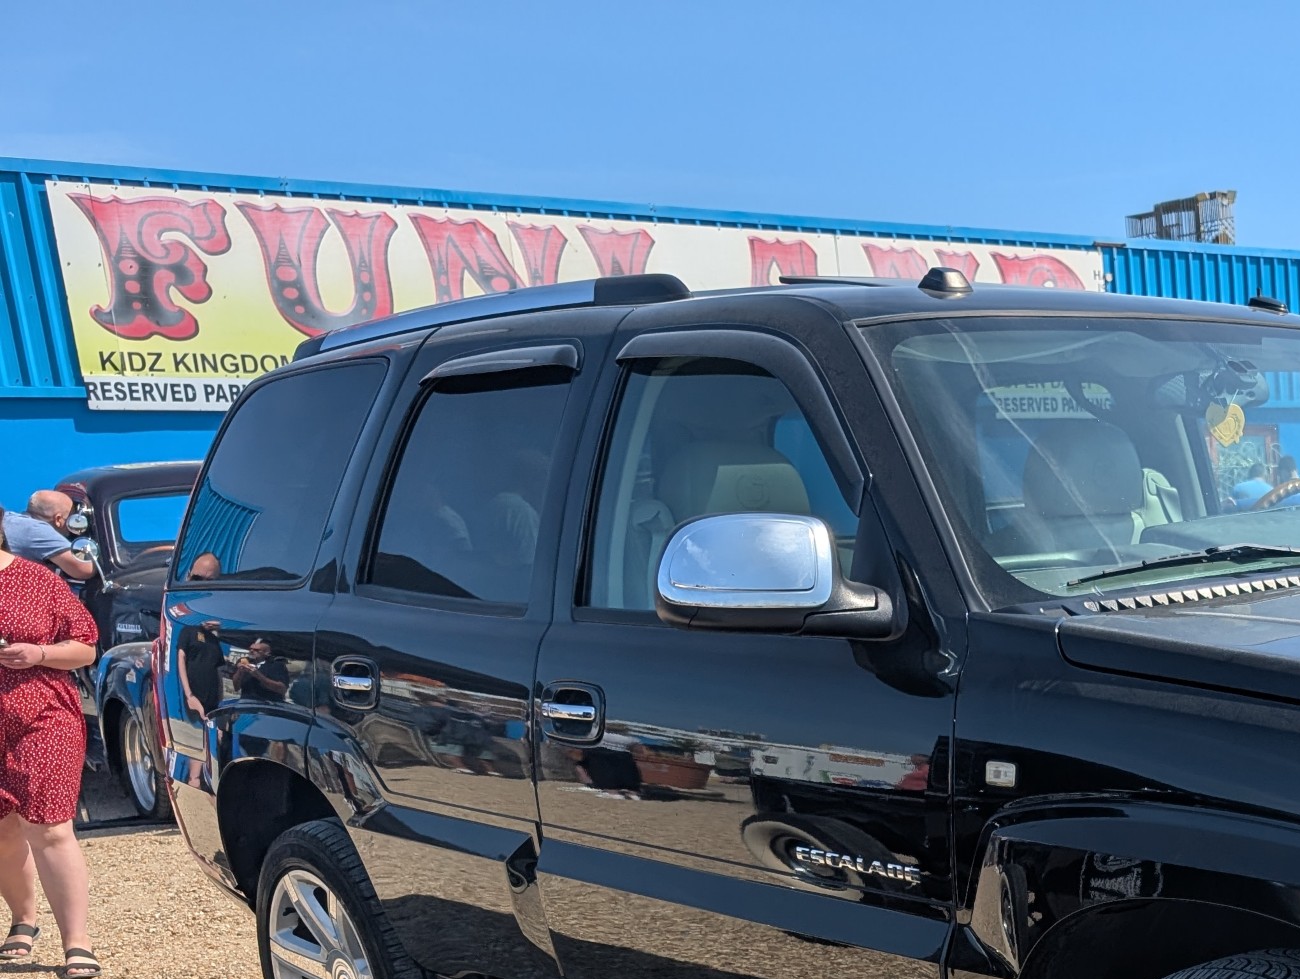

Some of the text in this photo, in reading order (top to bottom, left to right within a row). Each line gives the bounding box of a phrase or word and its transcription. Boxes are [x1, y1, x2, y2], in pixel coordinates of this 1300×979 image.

[98, 351, 292, 375] KIDZ KINGDO
[84, 381, 246, 404] RESERVED PAR
[796, 846, 921, 884] ESCALADE
